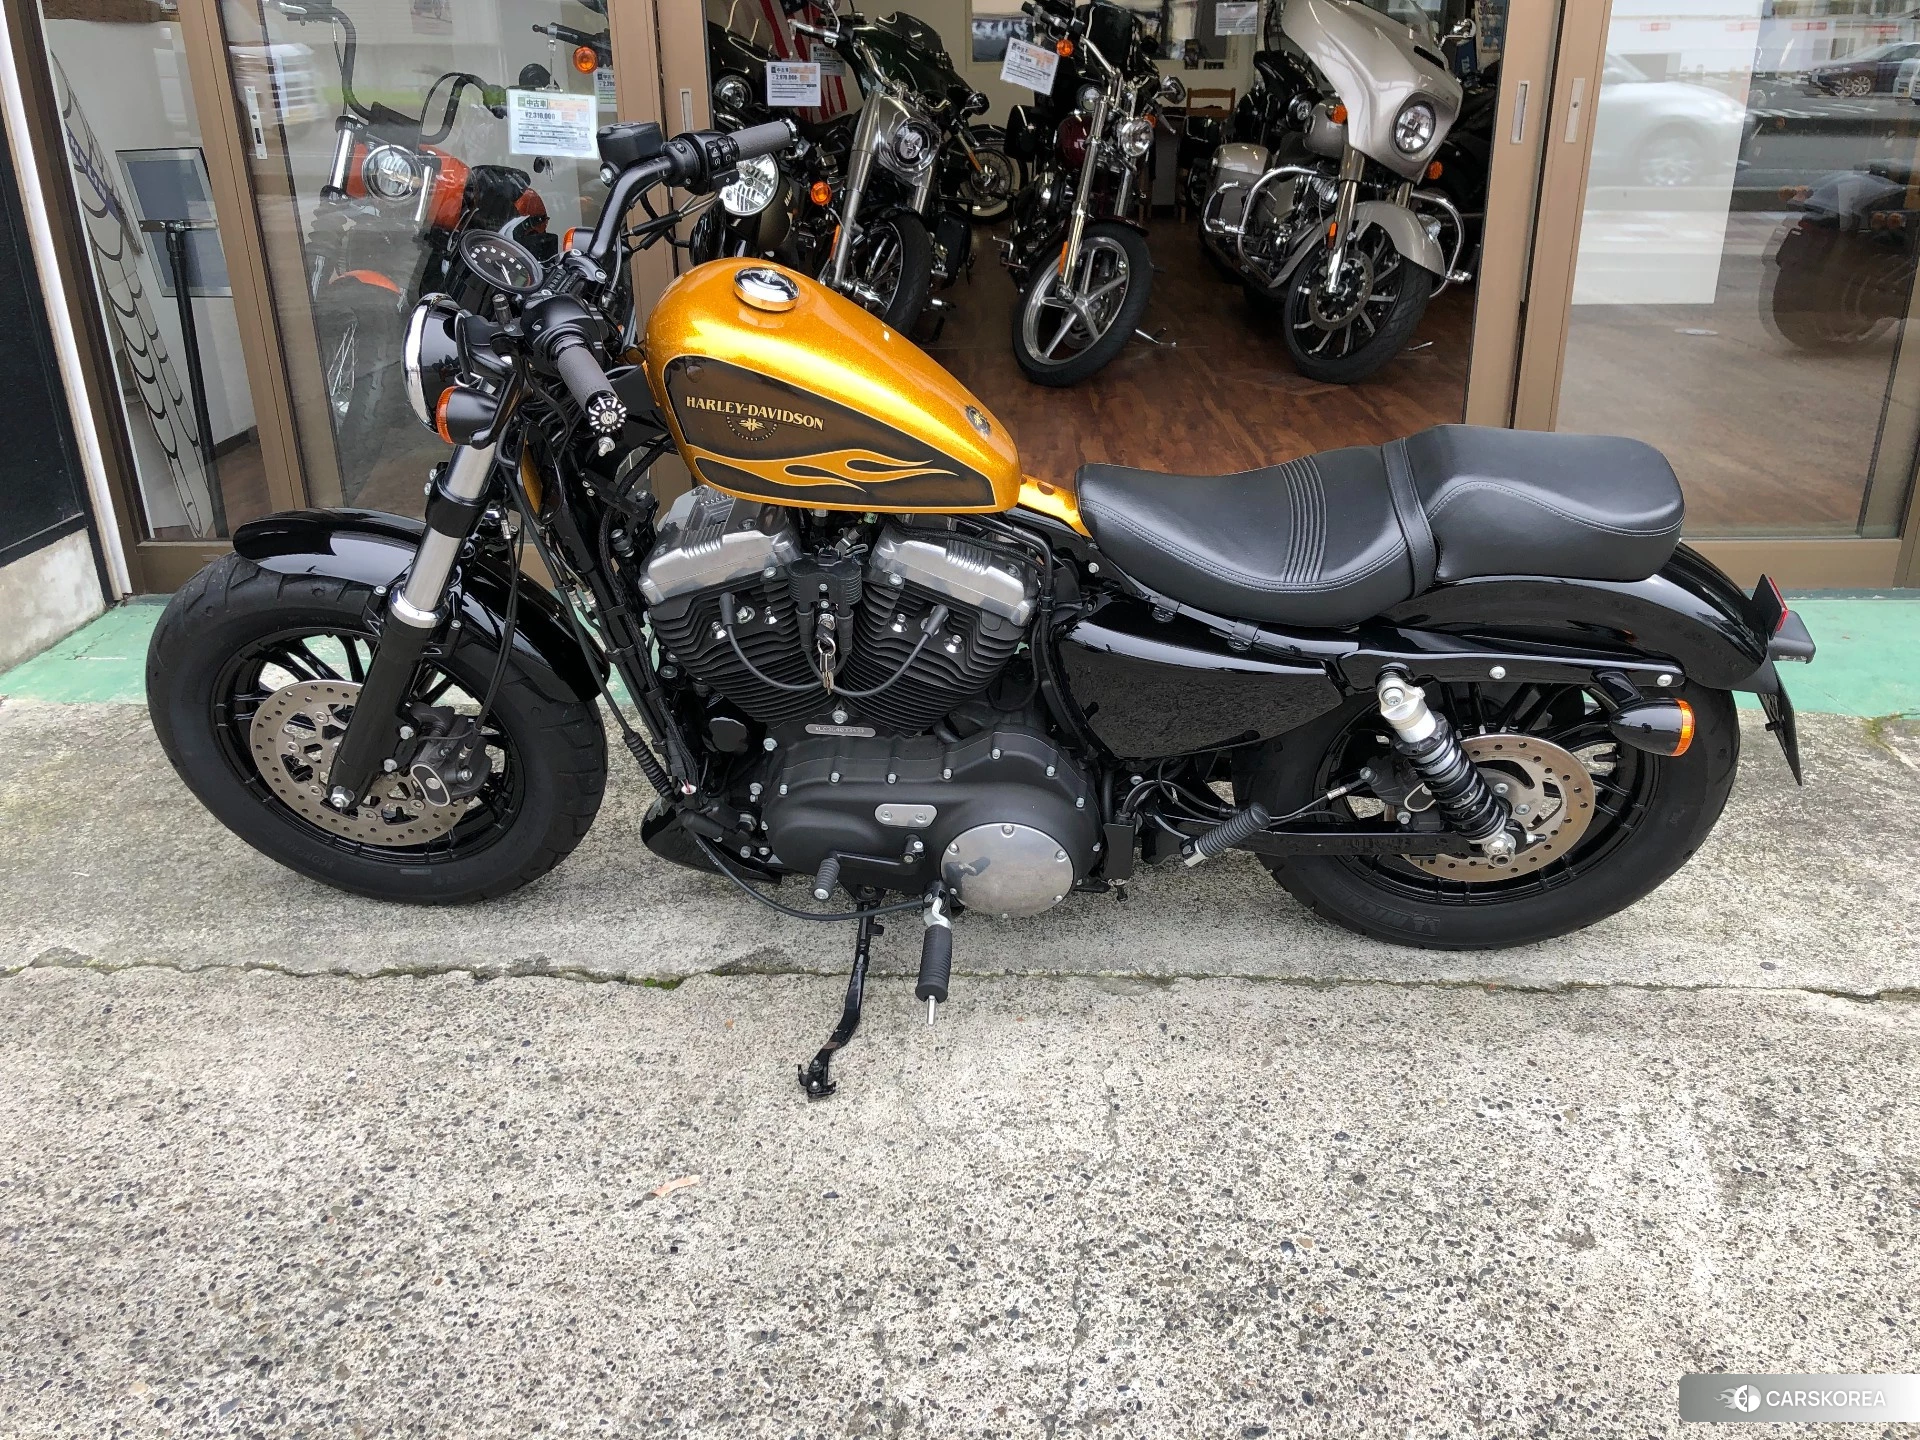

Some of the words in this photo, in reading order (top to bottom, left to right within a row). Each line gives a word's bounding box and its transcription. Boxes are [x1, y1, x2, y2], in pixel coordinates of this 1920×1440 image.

[526, 98, 547, 108] 中古車
[686, 395, 825, 431] HARLEY-DAVIDSON
